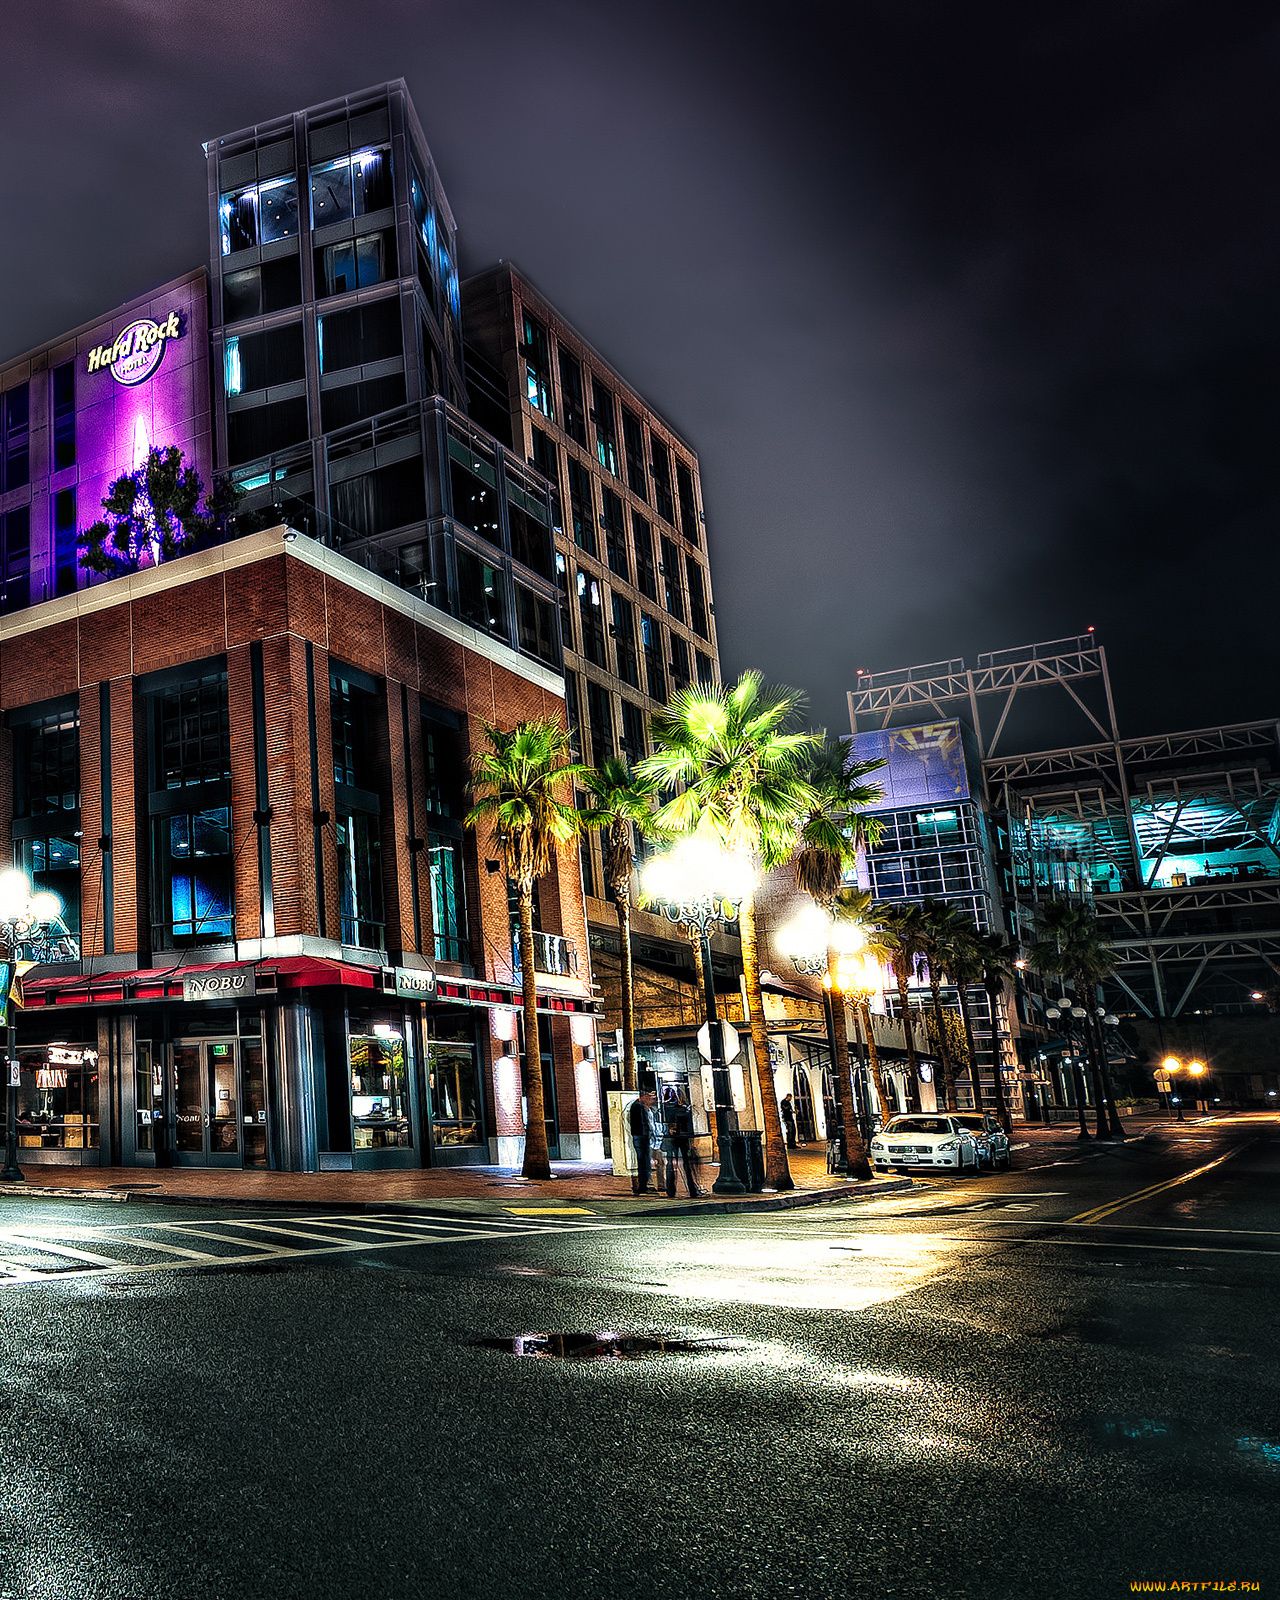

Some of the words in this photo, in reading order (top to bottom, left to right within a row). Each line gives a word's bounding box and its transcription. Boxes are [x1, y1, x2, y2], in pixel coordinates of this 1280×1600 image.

[88, 332, 133, 373] Hard
[134, 311, 180, 353] Rock
[121, 357, 149, 375] HOTEL
[190, 975, 247, 992] NOBU
[399, 974, 435, 992] NOBU
